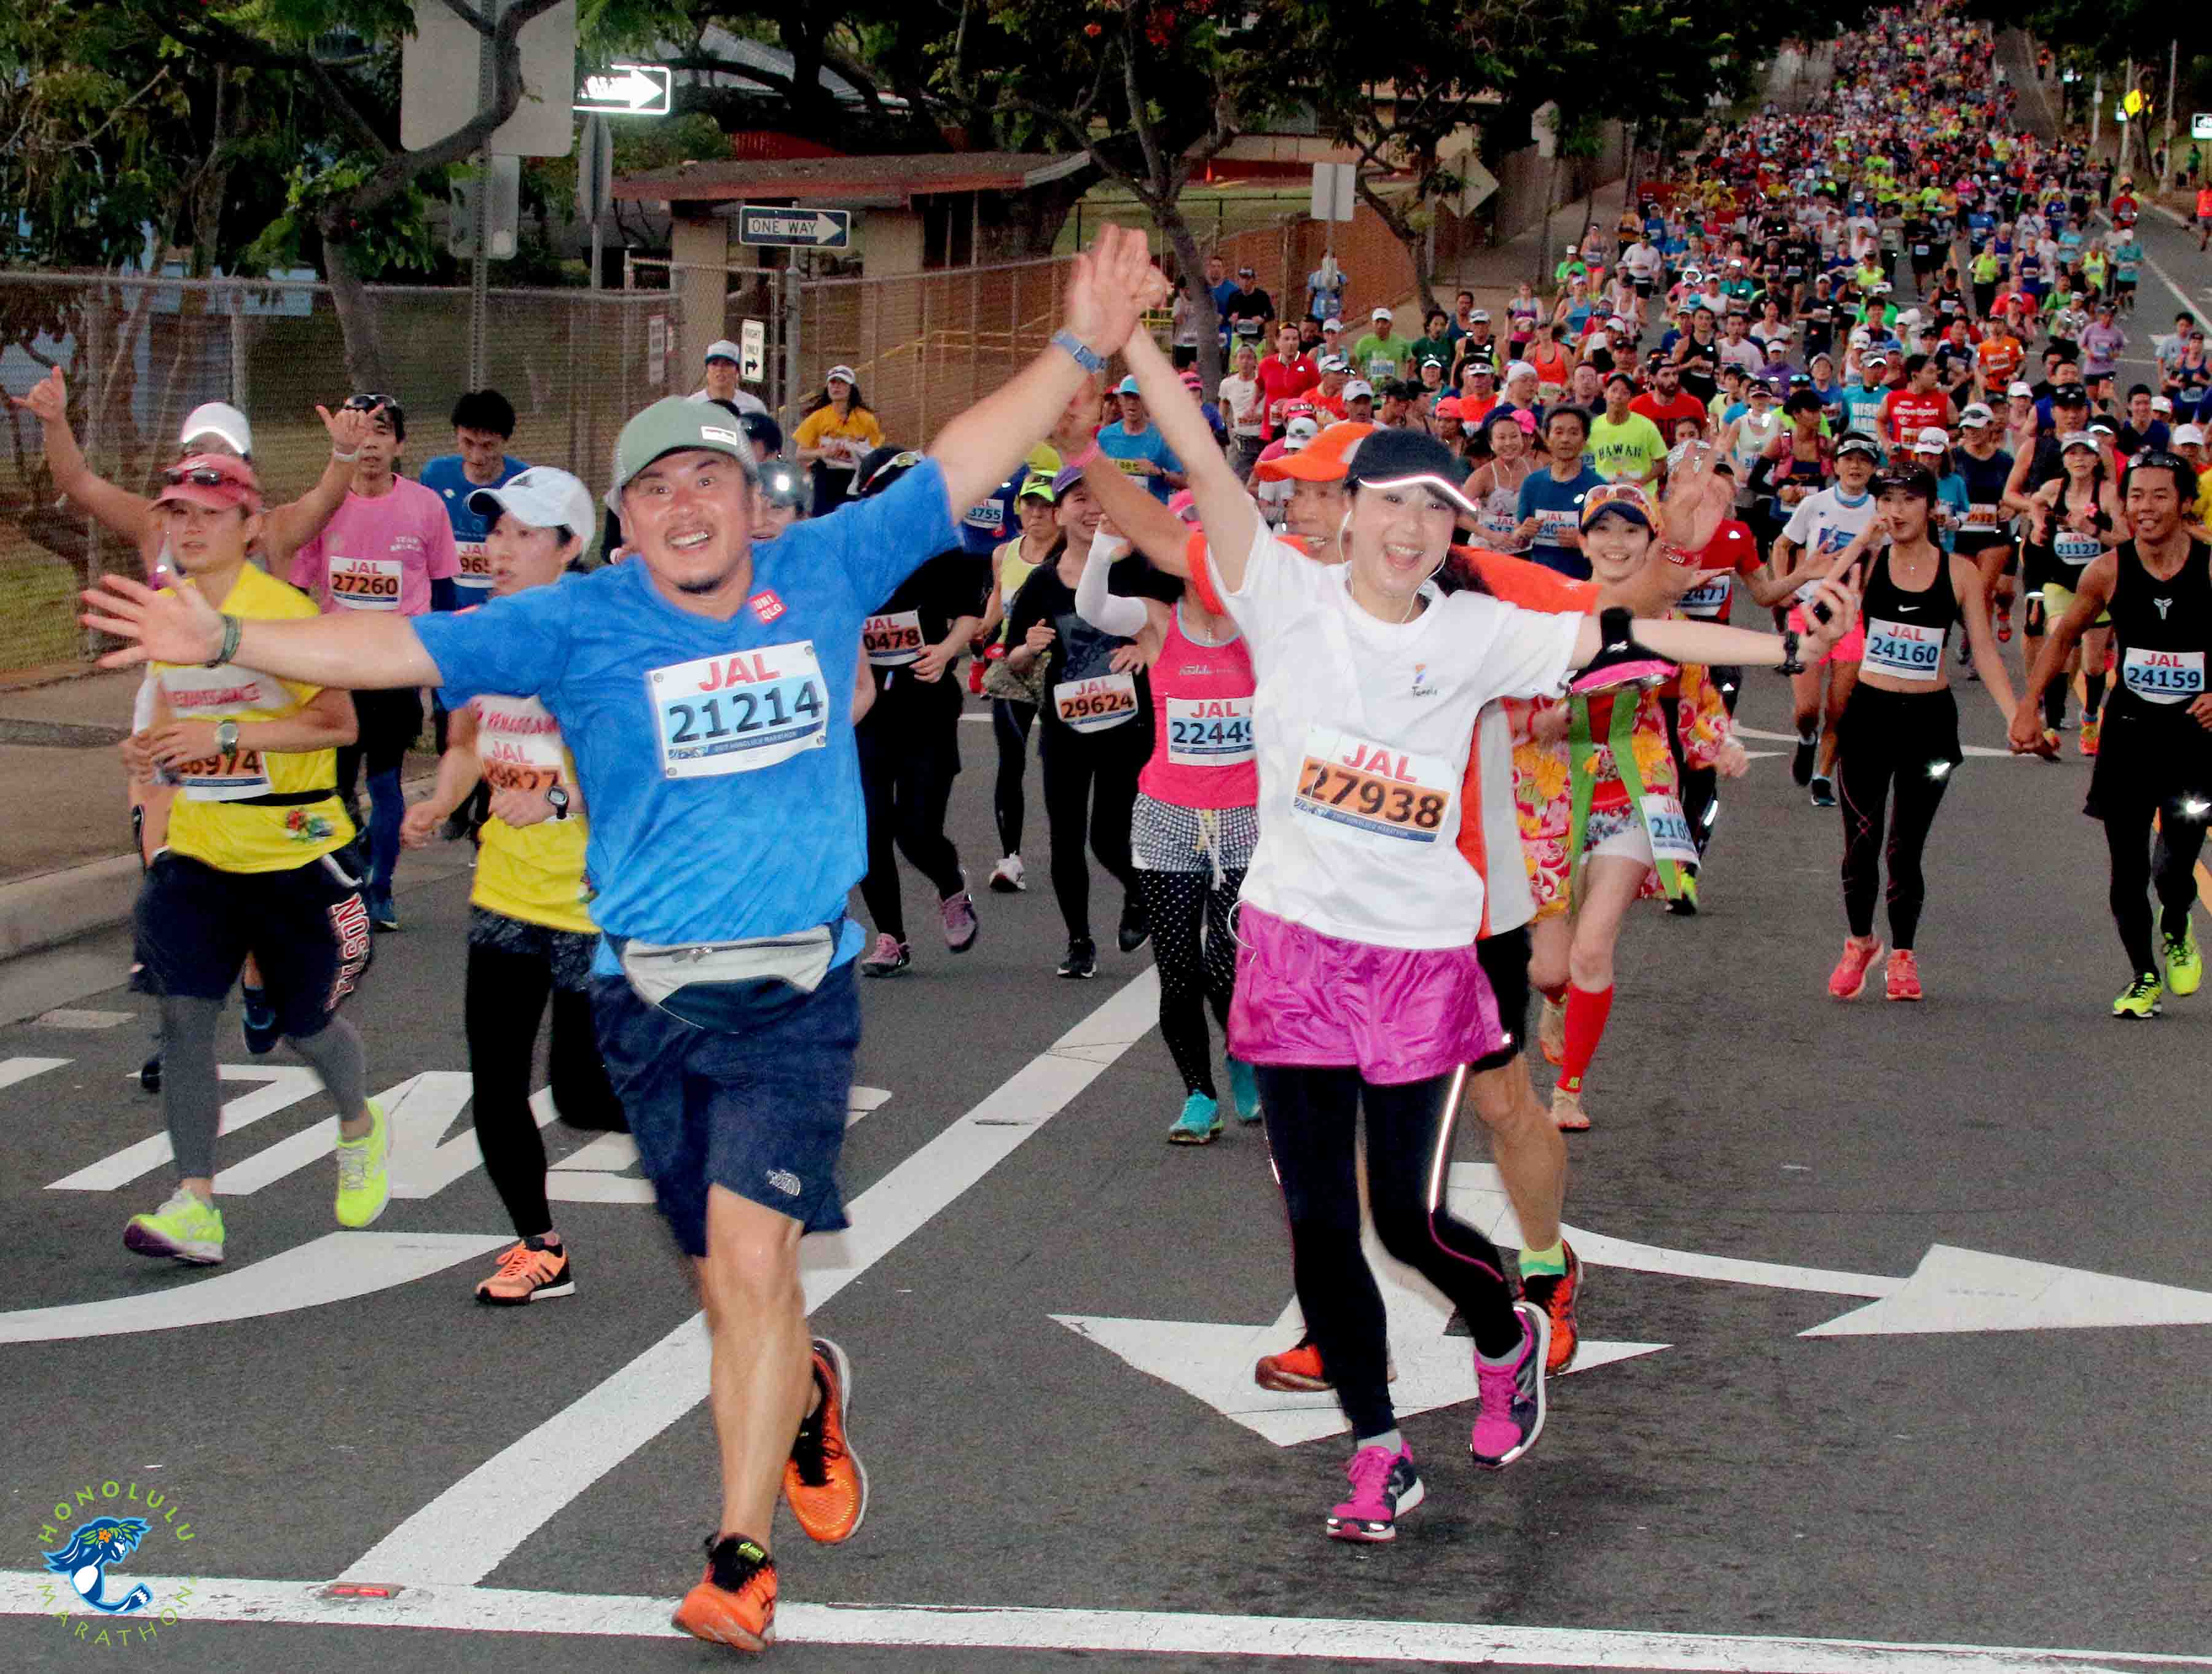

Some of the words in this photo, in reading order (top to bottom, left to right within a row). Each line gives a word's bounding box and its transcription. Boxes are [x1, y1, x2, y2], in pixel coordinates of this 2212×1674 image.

[752, 219, 780, 233] ONE
[788, 221, 816, 235] WAY
[347, 561, 383, 574] JAL
[332, 574, 398, 595] 27260
[753, 595, 773, 609] UNI
[761, 604, 782, 619] QLO
[865, 617, 900, 630] JAL
[1887, 625, 1927, 641] JAL
[1870, 636, 1938, 663] 24160
[2143, 653, 2184, 668] JAL
[698, 654, 780, 692] JAL
[2128, 667, 2200, 688] 24159
[1075, 678, 1110, 695] JAL
[669, 681, 823, 743] 21214
[1062, 693, 1134, 719] 29624
[1190, 702, 1241, 724] JAL
[492, 739, 535, 764] JAL
[1343, 744, 1418, 783] JAL
[1295, 764, 1445, 828] 27938
